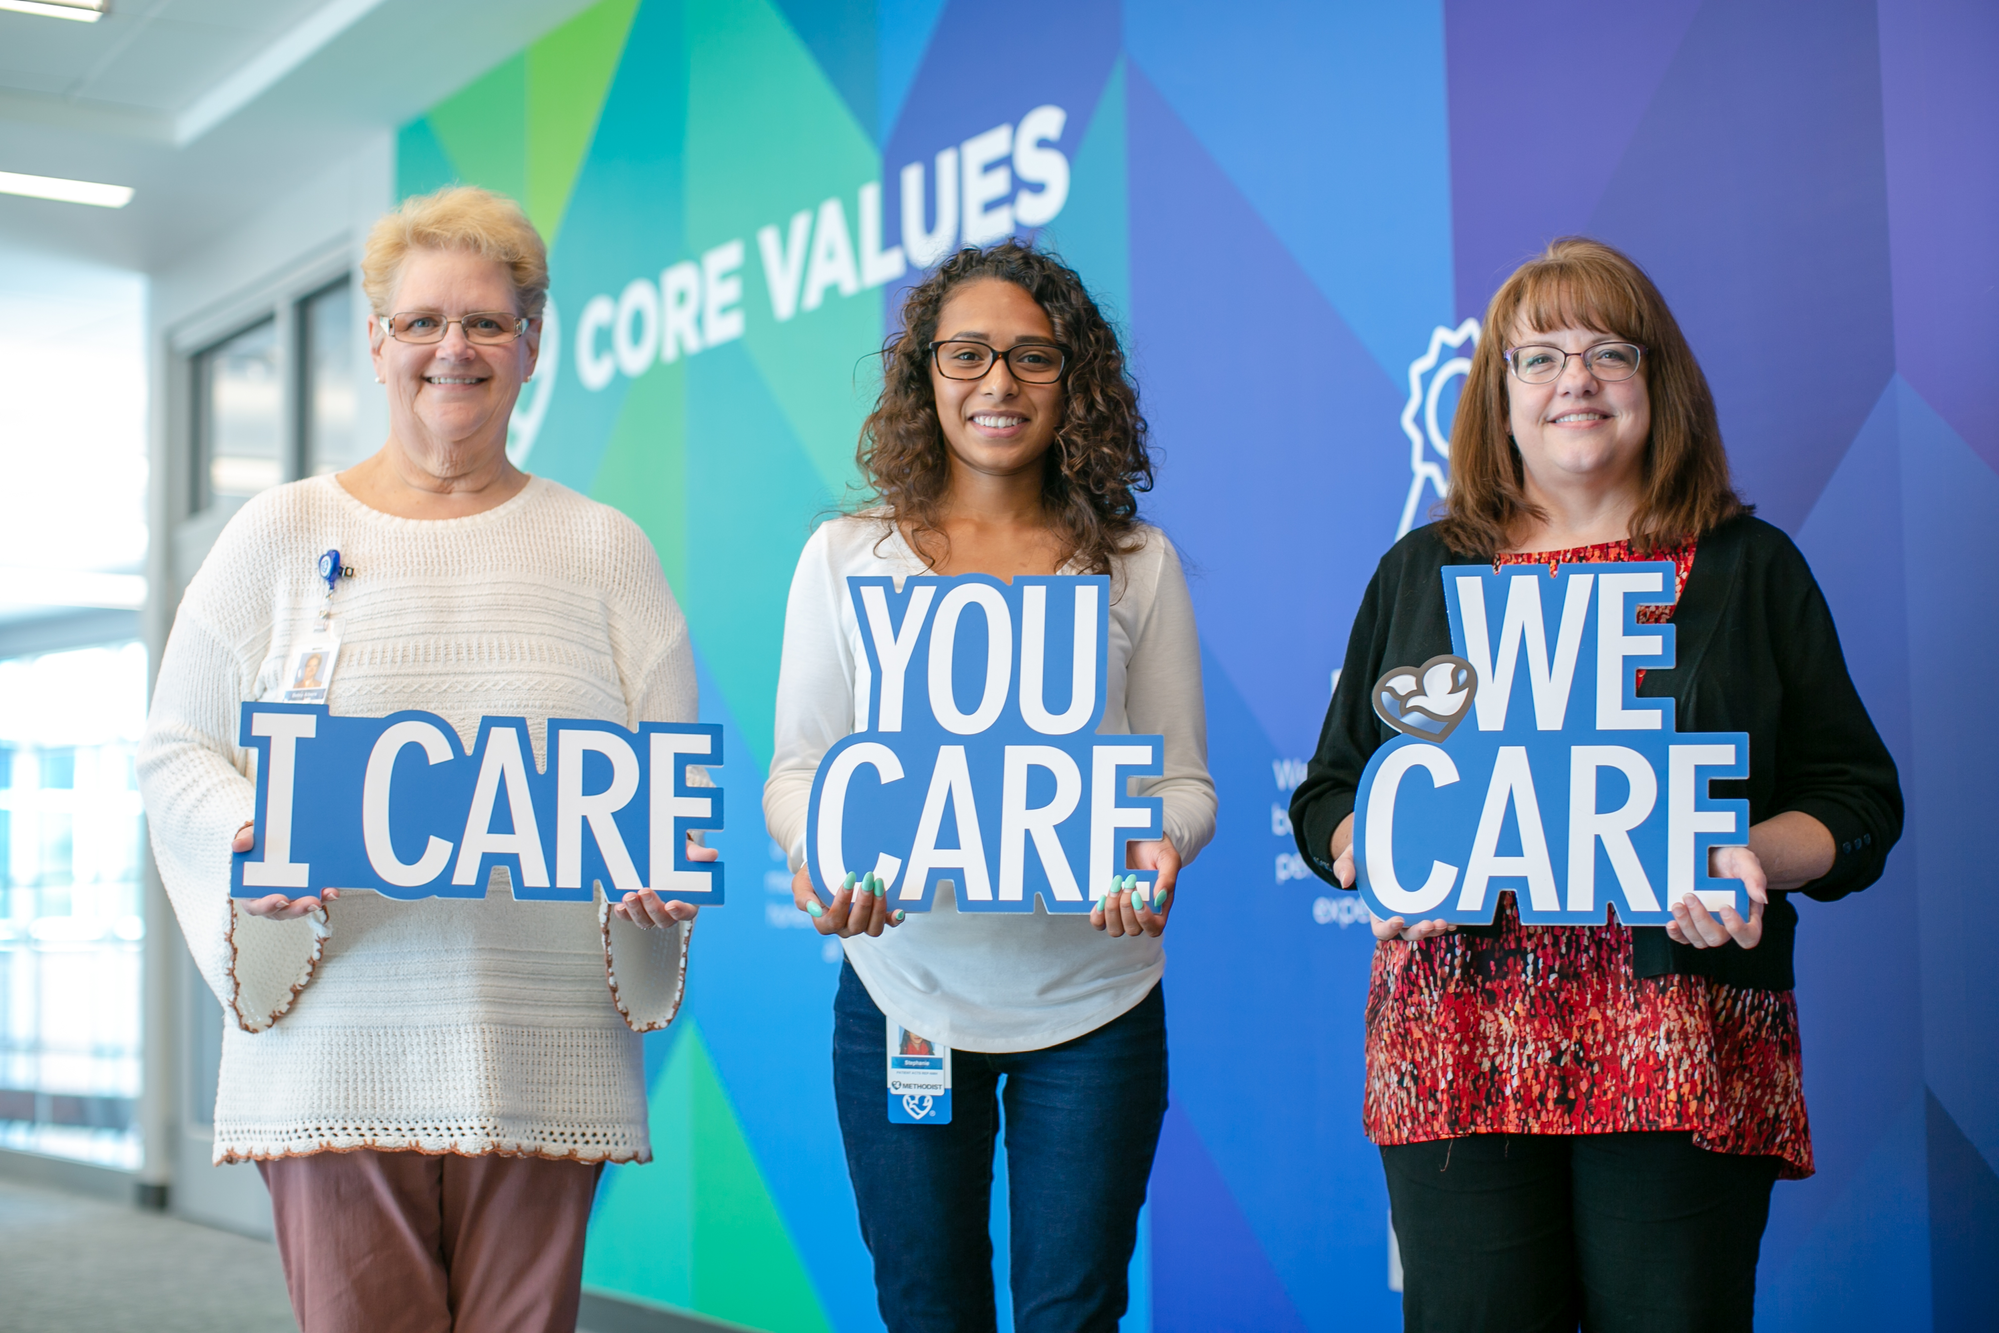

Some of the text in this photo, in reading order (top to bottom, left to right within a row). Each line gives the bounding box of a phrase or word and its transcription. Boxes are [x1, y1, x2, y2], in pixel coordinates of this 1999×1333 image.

[575, 104, 1071, 391] CORE VALUES
[860, 582, 1099, 735] YOU
[1455, 572, 1663, 732] WE
[243, 712, 712, 892] I CARE
[817, 741, 1153, 902] CARE
[1364, 743, 1736, 914] CARE
